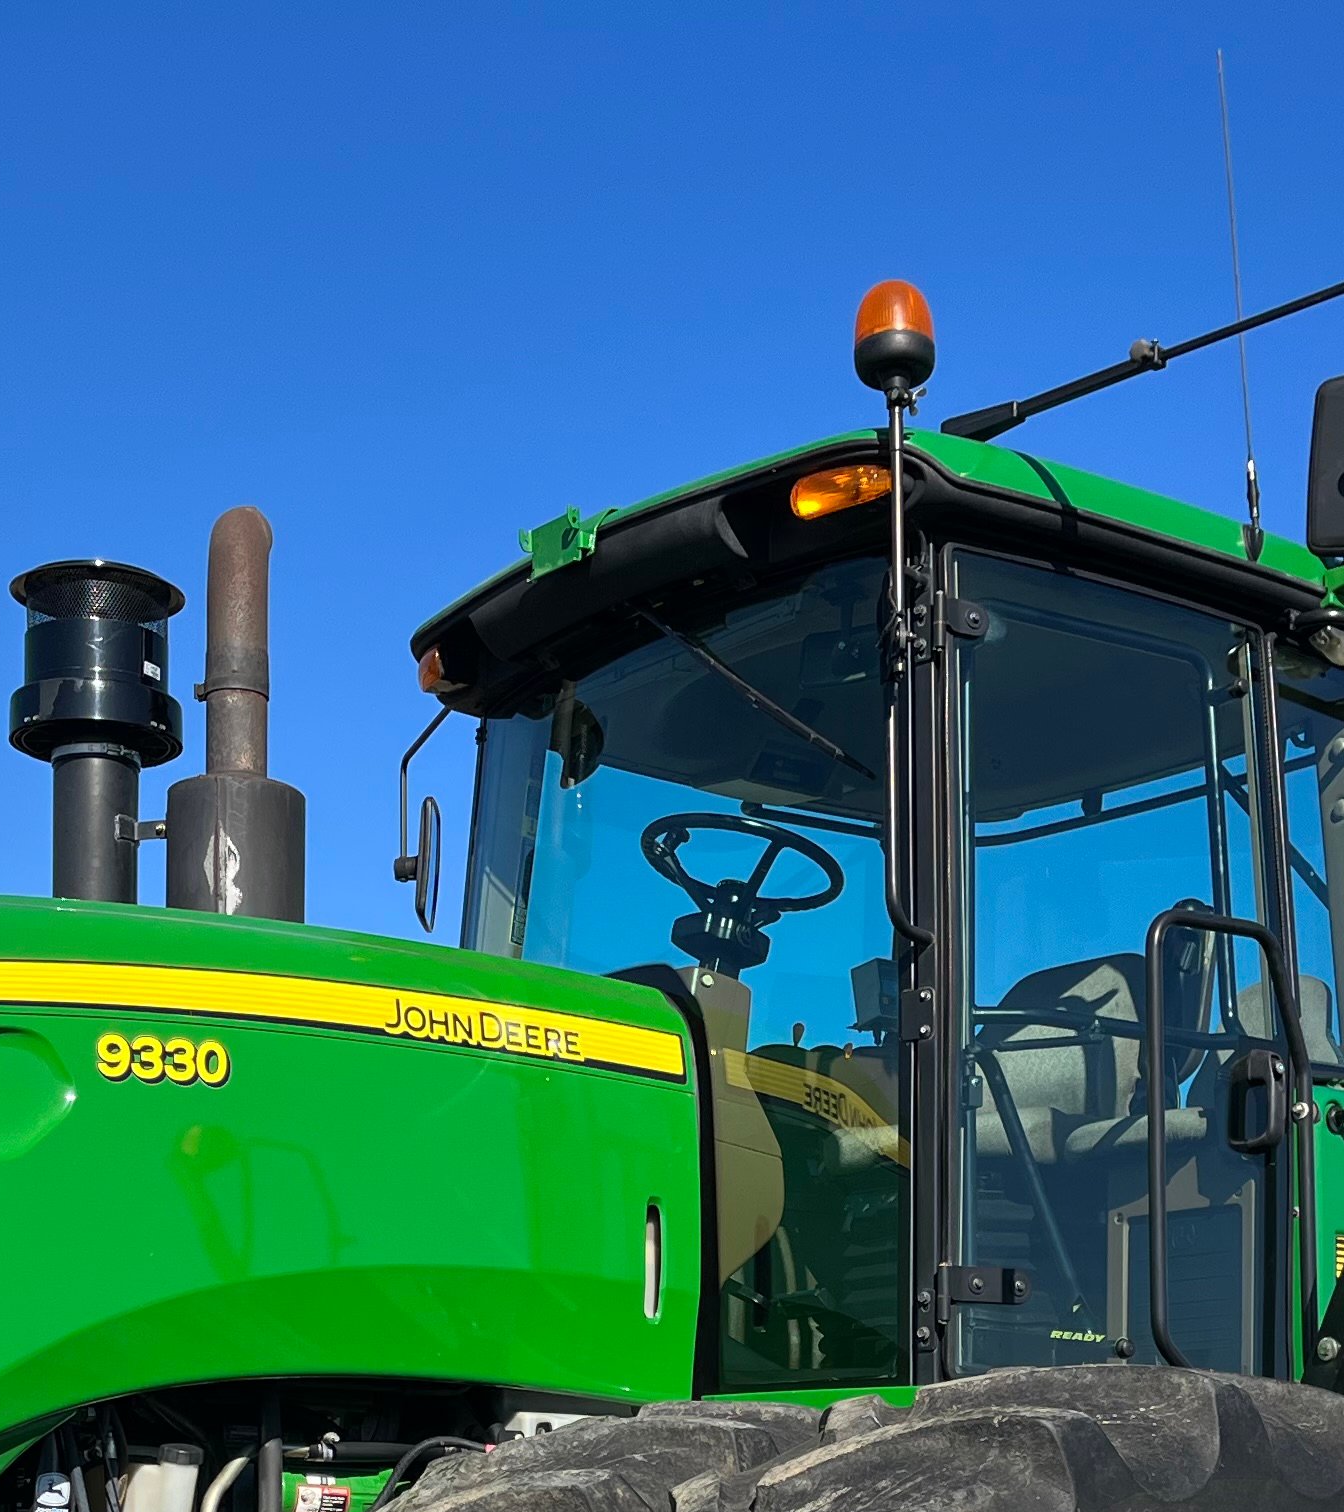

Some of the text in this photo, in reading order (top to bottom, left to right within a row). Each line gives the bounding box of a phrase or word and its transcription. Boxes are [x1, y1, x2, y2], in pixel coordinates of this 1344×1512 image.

[384, 998, 583, 1058] JOHN DEERE
[97, 1034, 229, 1086] 9330
[1050, 1330, 1106, 1343] READY
